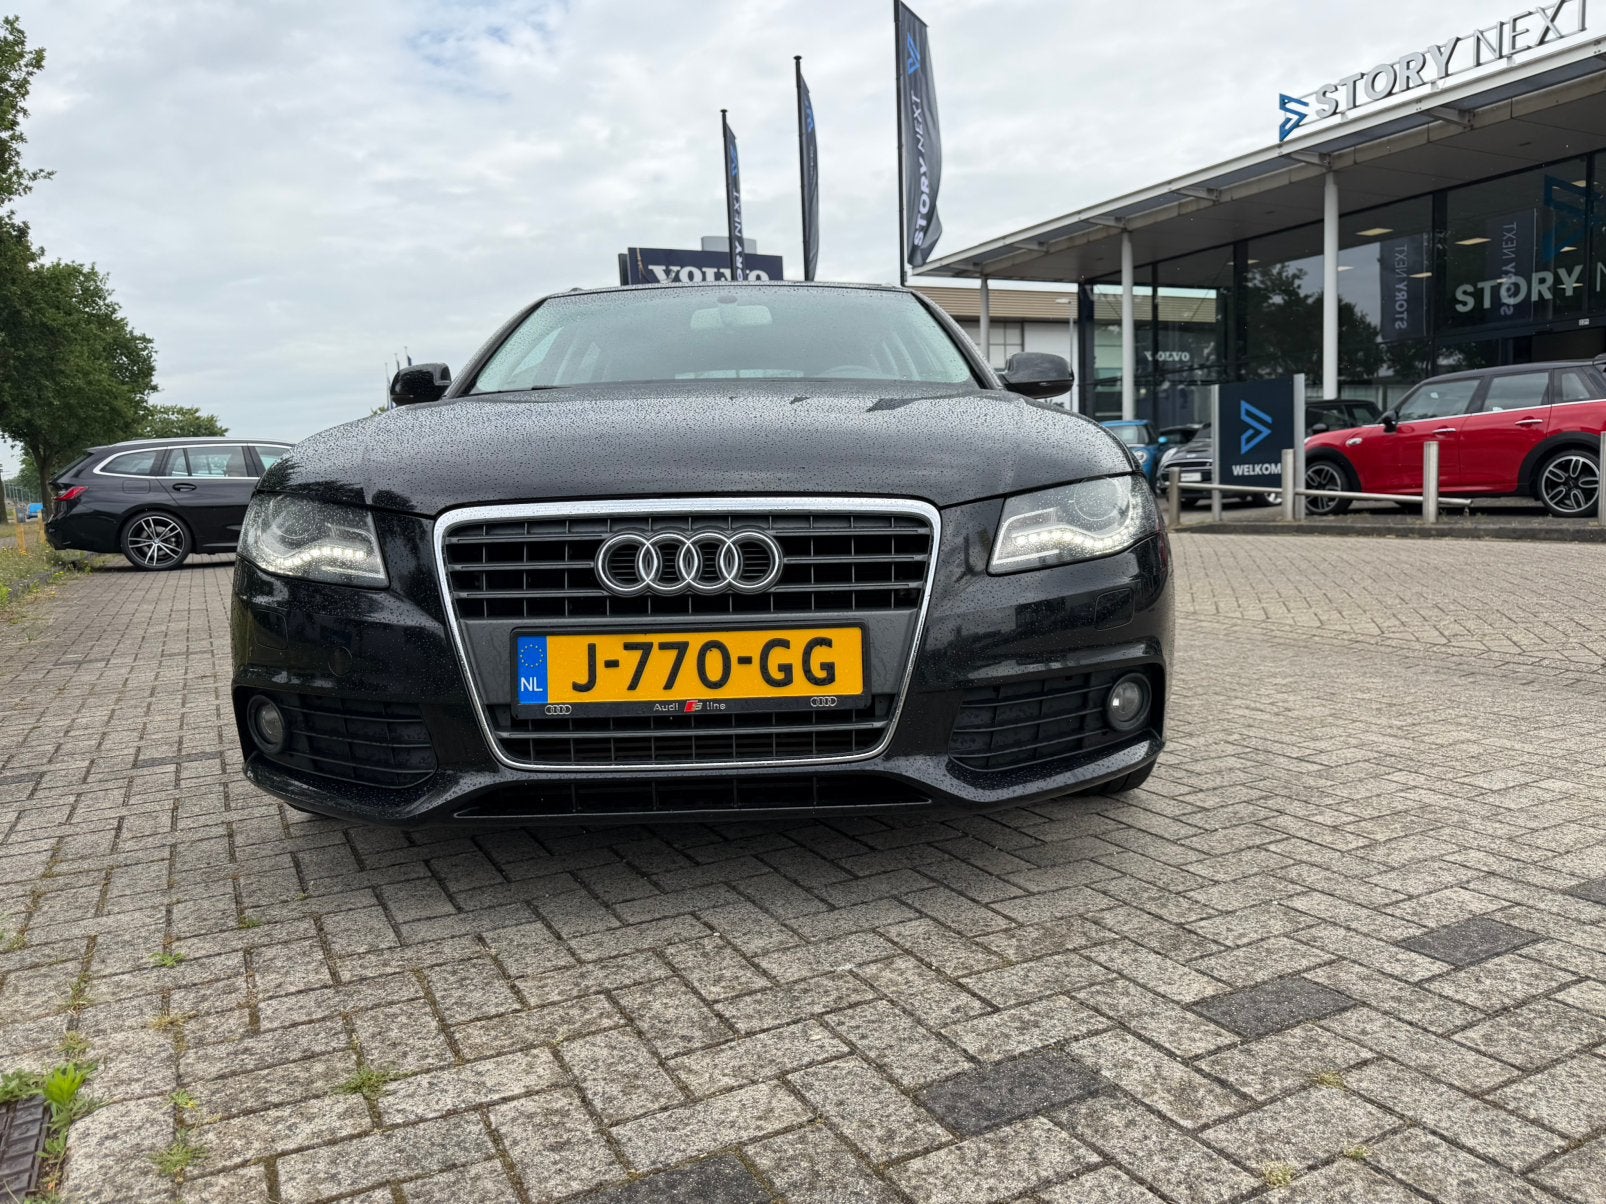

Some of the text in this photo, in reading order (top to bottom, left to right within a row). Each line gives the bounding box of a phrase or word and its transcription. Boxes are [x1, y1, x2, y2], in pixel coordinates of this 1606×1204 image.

[1315, 0, 1588, 119] STORY NEXT
[911, 90, 930, 246] STORY NEXT
[735, 241, 744, 282] ORY
[1455, 265, 1584, 313] STORY
[1232, 463, 1281, 476] WELKOM
[520, 677, 543, 692] NL
[571, 637, 837, 693] J-770-GG
[653, 703, 679, 711] Audi
[706, 702, 726, 710] line
